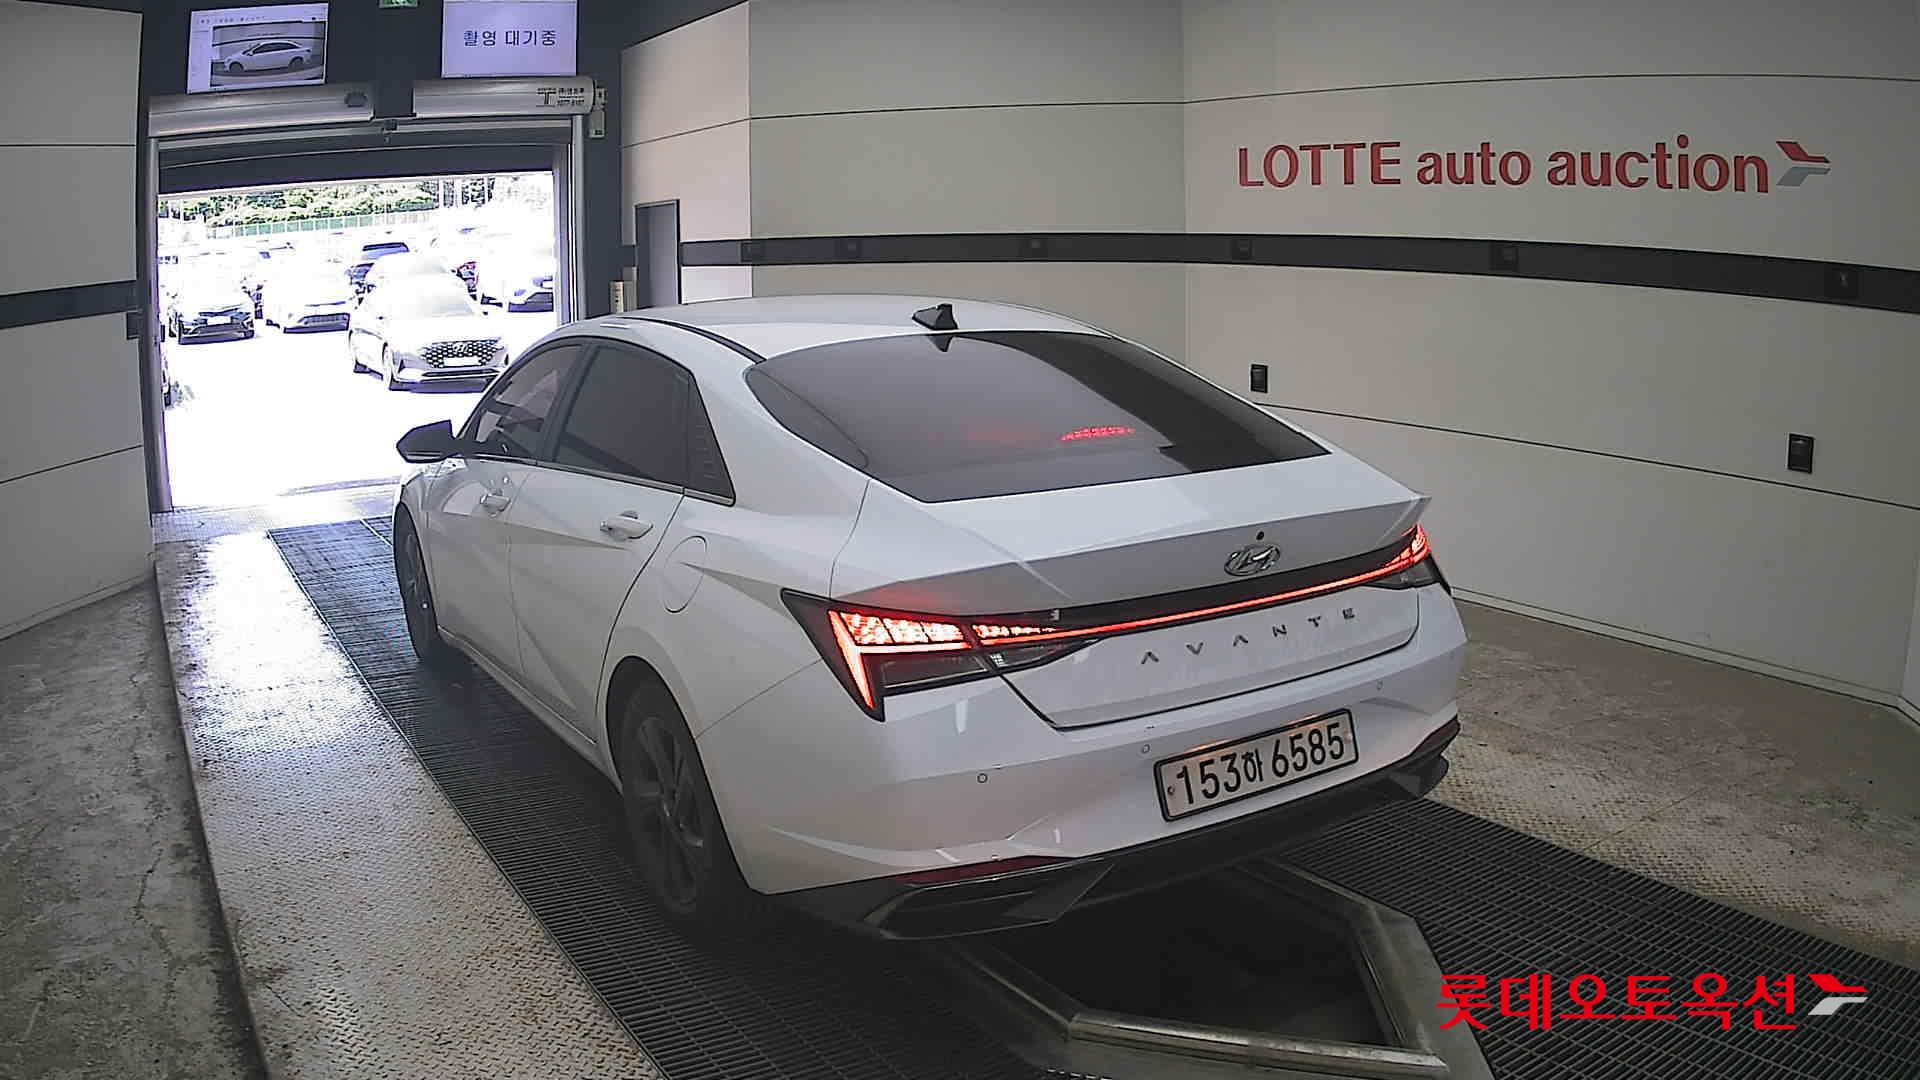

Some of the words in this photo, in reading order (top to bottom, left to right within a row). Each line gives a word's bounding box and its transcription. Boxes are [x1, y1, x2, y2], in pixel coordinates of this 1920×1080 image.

[463, 30, 497, 47] 촬영
[505, 30, 557, 47] 대기중
[1238, 141, 1401, 188] LOTTE
[1416, 142, 1532, 187] auto
[1547, 135, 1770, 194] auction
[1141, 607, 1356, 665] AVANTE
[1176, 748, 1264, 805] 153하
[1271, 721, 1345, 778] 6585
